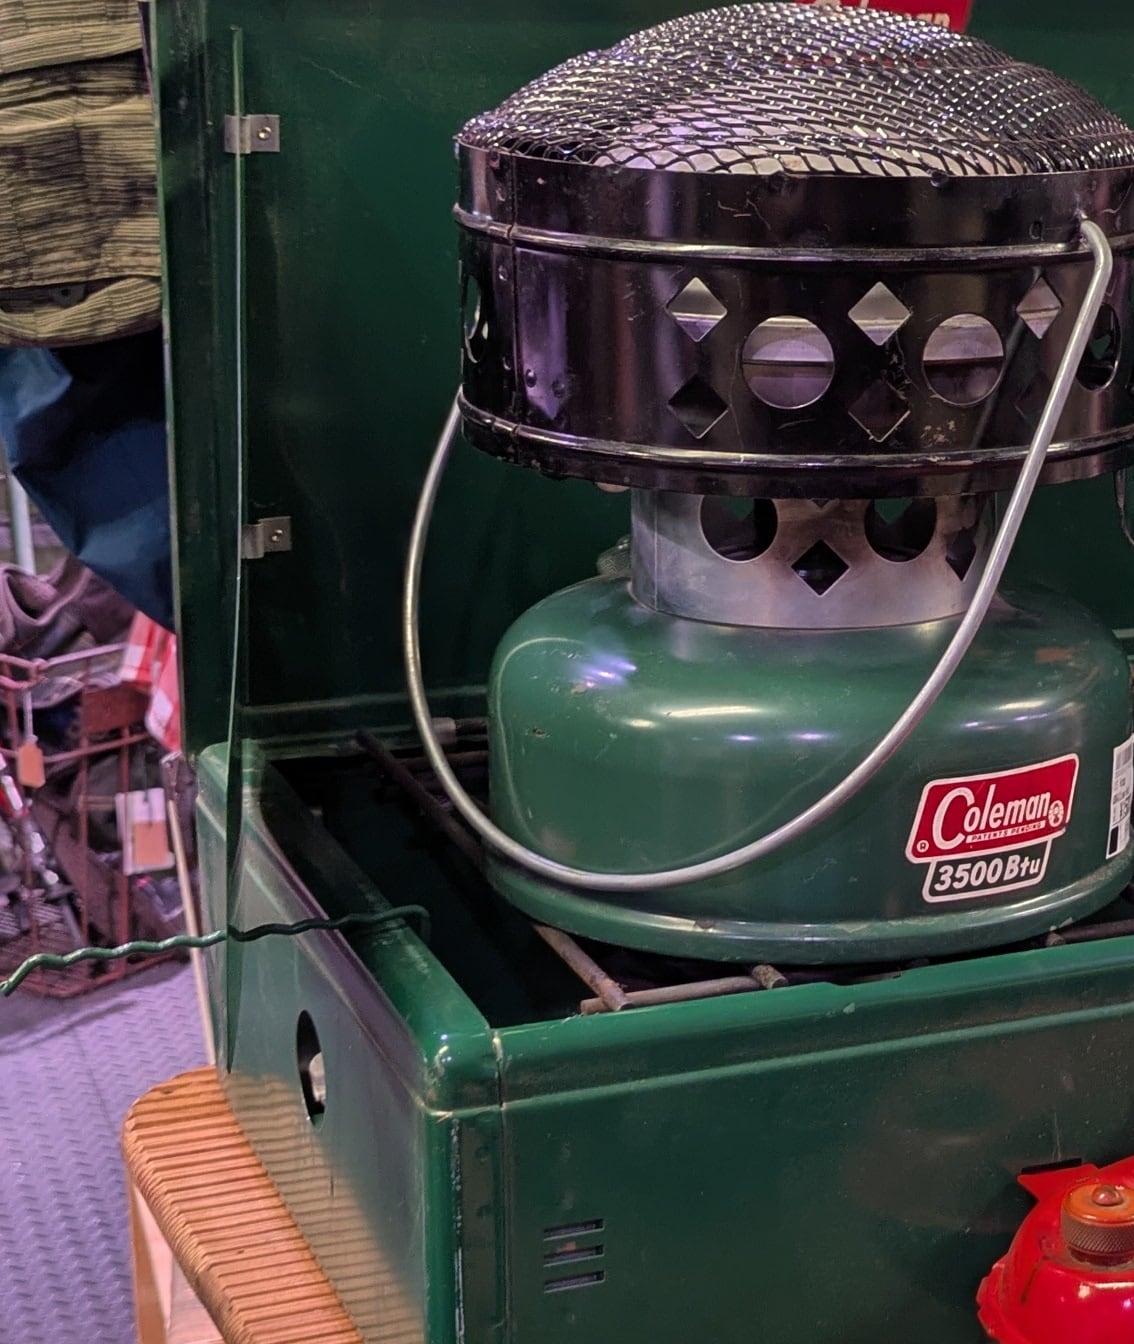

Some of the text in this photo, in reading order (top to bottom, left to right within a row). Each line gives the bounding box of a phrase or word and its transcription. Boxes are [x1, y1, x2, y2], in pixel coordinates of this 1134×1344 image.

[932, 783, 1051, 850] Coleman
[971, 822, 1042, 841] PATENTS PENDING
[934, 858, 1001, 892] 3500
